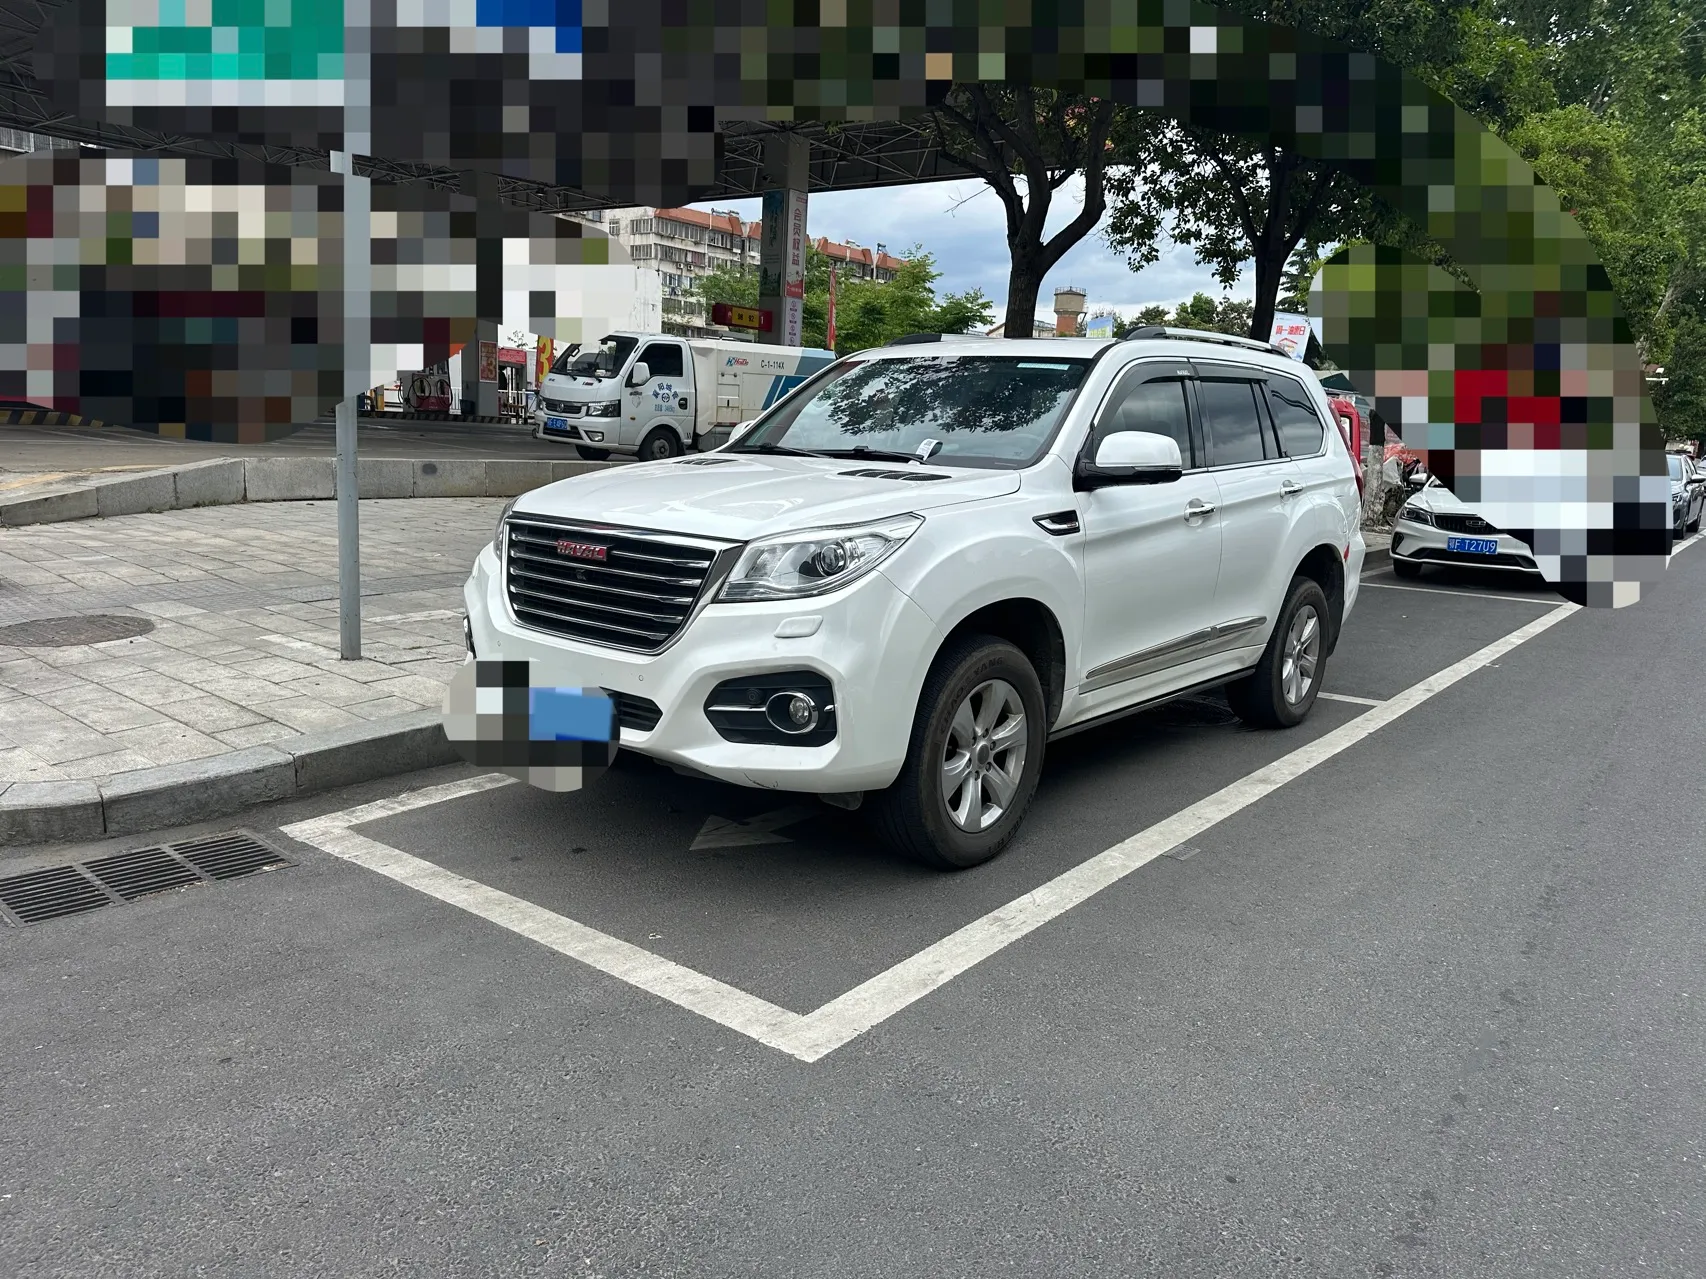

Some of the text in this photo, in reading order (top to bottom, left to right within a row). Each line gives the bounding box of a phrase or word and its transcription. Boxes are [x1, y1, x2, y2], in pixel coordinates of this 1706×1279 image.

[792, 207, 802, 266] 会员权益
[760, 360, 785, 370] C-1-114X
[557, 541, 605, 559] HAVAL
